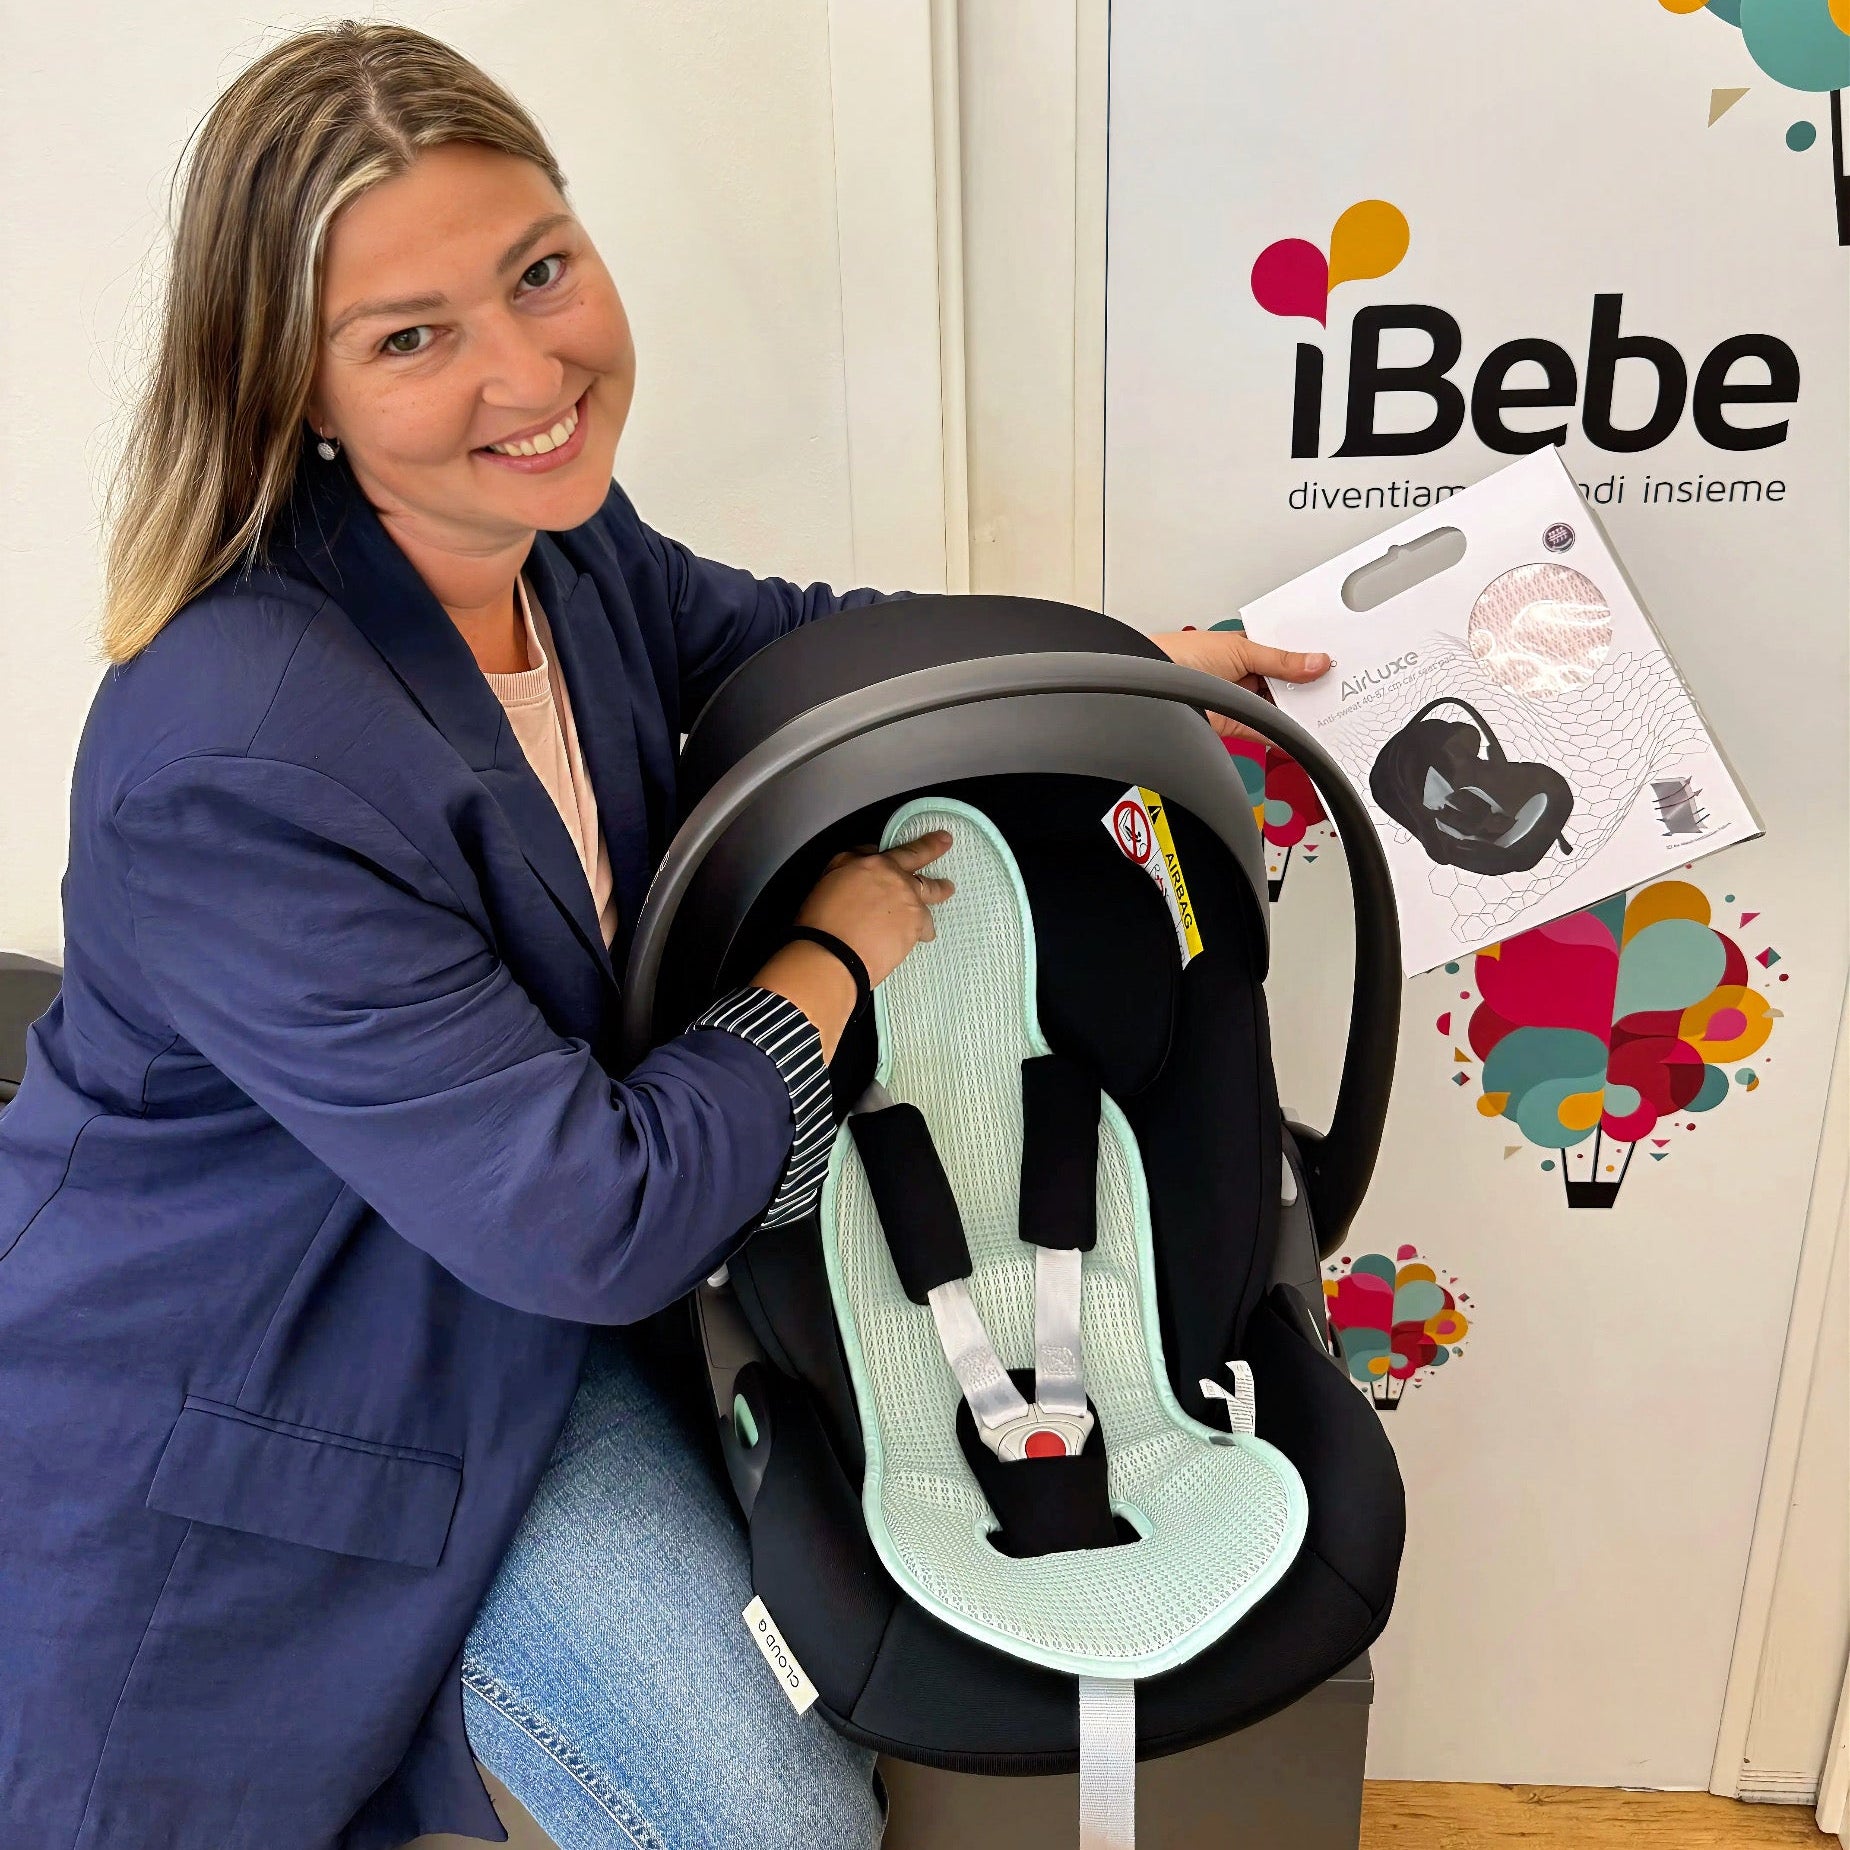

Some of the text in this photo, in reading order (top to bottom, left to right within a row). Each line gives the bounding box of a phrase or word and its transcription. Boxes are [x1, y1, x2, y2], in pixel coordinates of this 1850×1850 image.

[1290, 293, 1801, 459] iBebe
[1288, 480, 1468, 510] diventiam
[1643, 474, 1786, 504] insieme
[1341, 651, 1419, 702] AirLuxe
[1165, 853, 1192, 929] AIRBAG
[766, 1634, 799, 1687] CLOUD
